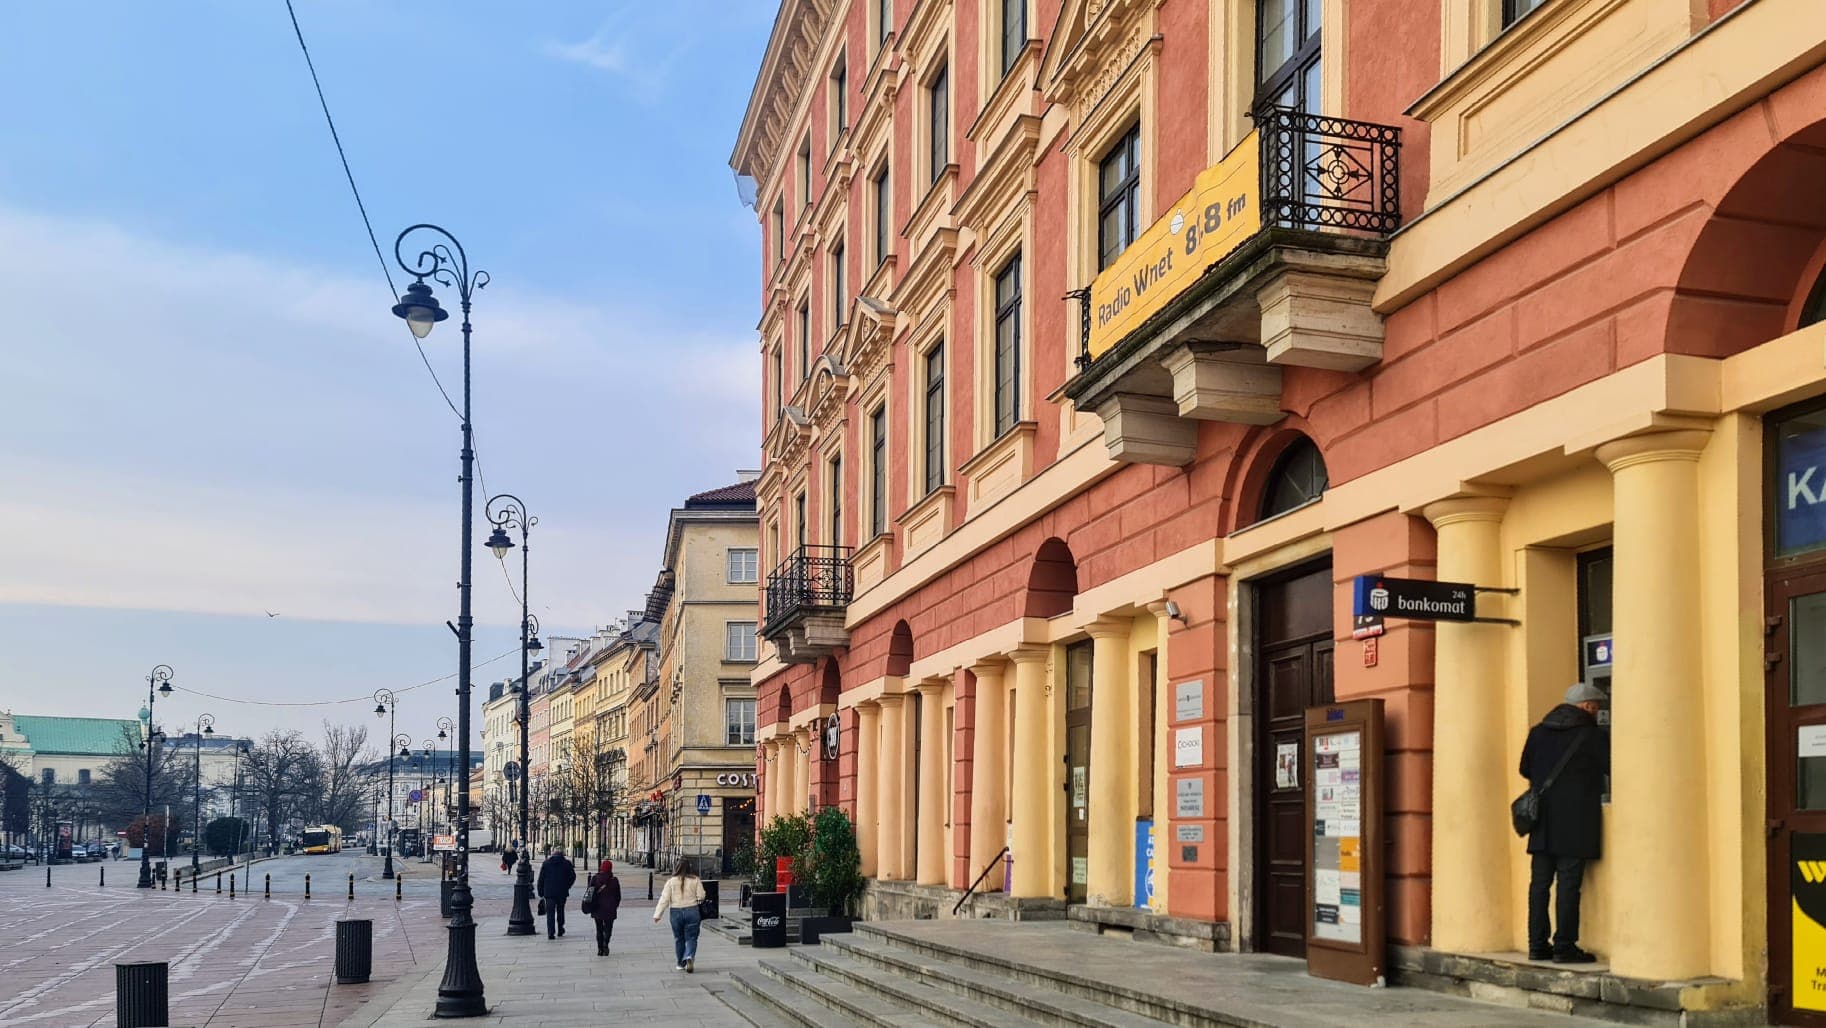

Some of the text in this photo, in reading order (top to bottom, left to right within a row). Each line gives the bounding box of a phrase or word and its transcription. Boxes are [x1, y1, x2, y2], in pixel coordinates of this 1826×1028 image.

[1098, 286, 1131, 329] Radio
[1133, 247, 1173, 297] Wnet
[1227, 193, 1246, 222] fm
[1452, 590, 1467, 599] 24h
[1398, 595, 1465, 614] bankomat
